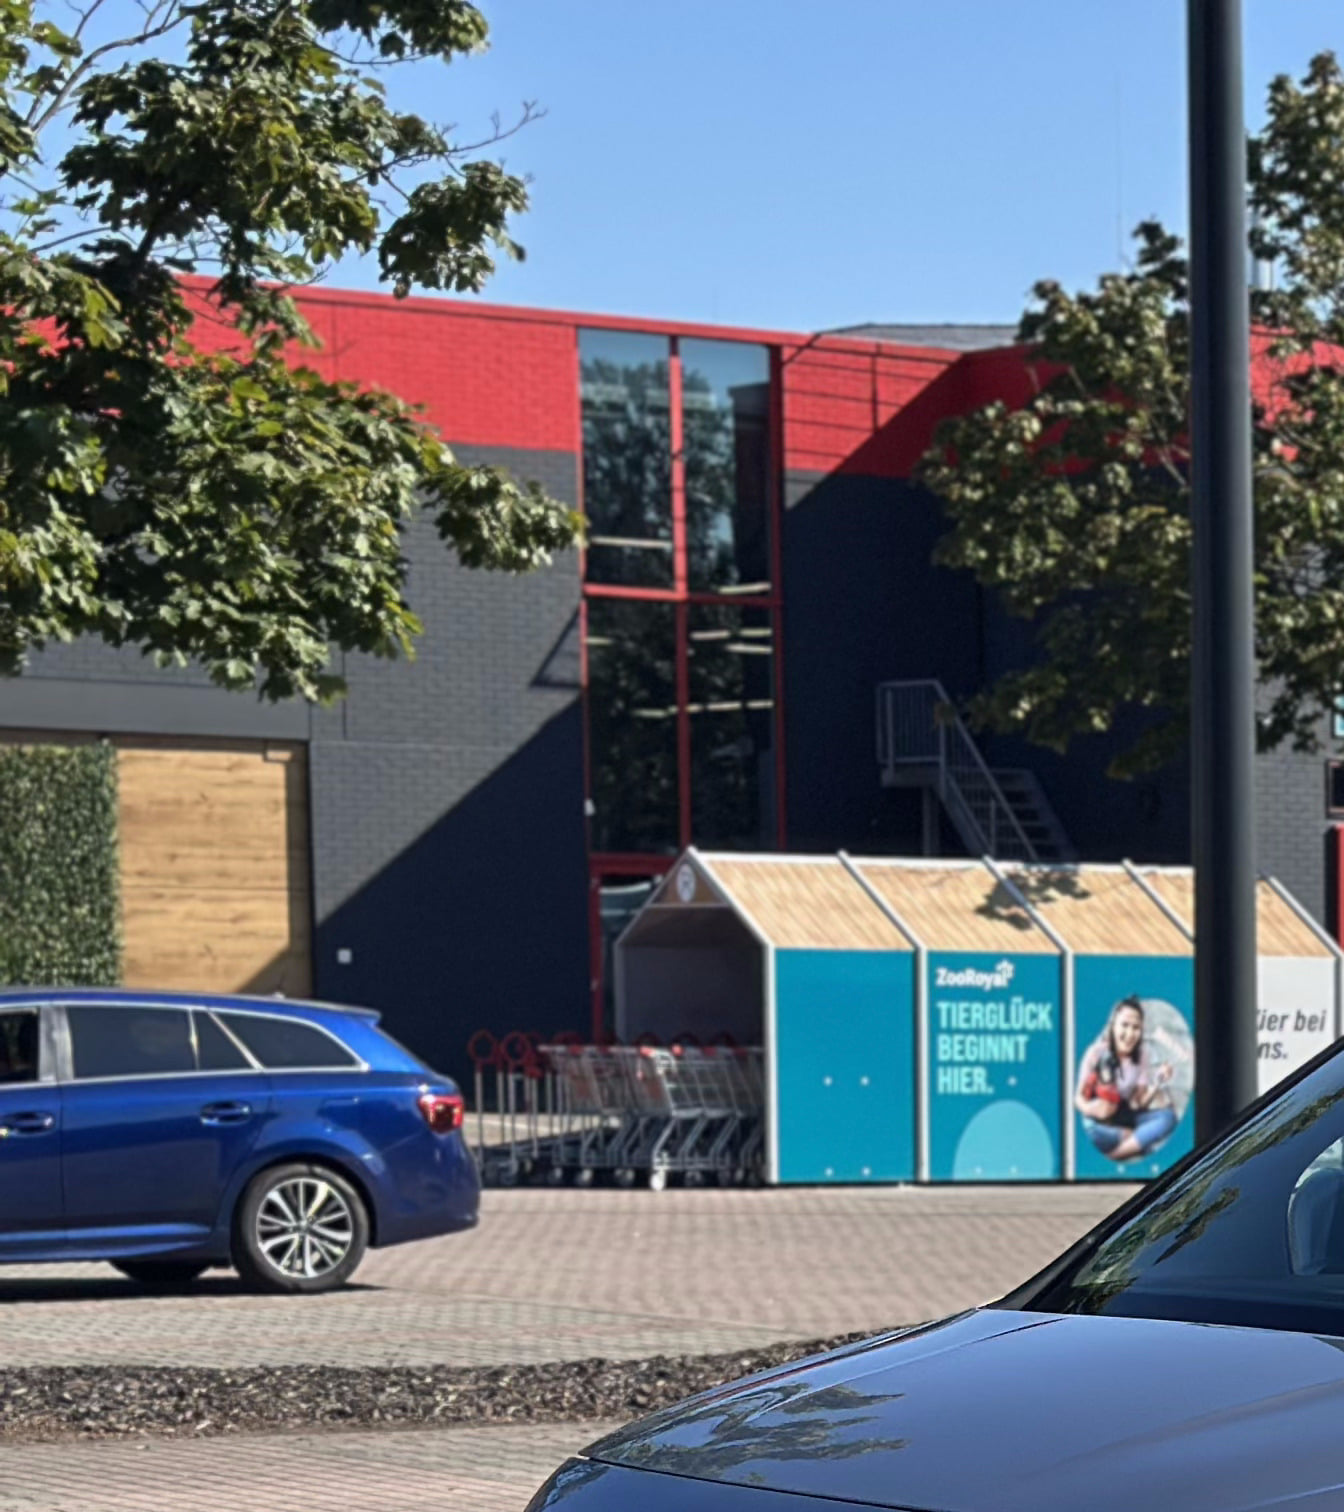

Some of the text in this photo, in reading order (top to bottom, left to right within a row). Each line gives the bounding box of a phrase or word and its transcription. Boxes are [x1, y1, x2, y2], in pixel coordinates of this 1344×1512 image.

[936, 959, 1011, 991] ZooRoyal
[936, 996, 1054, 1031] TIERGLÜCK
[1257, 1008, 1327, 1032] ier bei
[937, 1033, 1030, 1062] BEGINNT
[1257, 1041, 1287, 1060] ns.
[937, 1065, 995, 1094] HIER.
